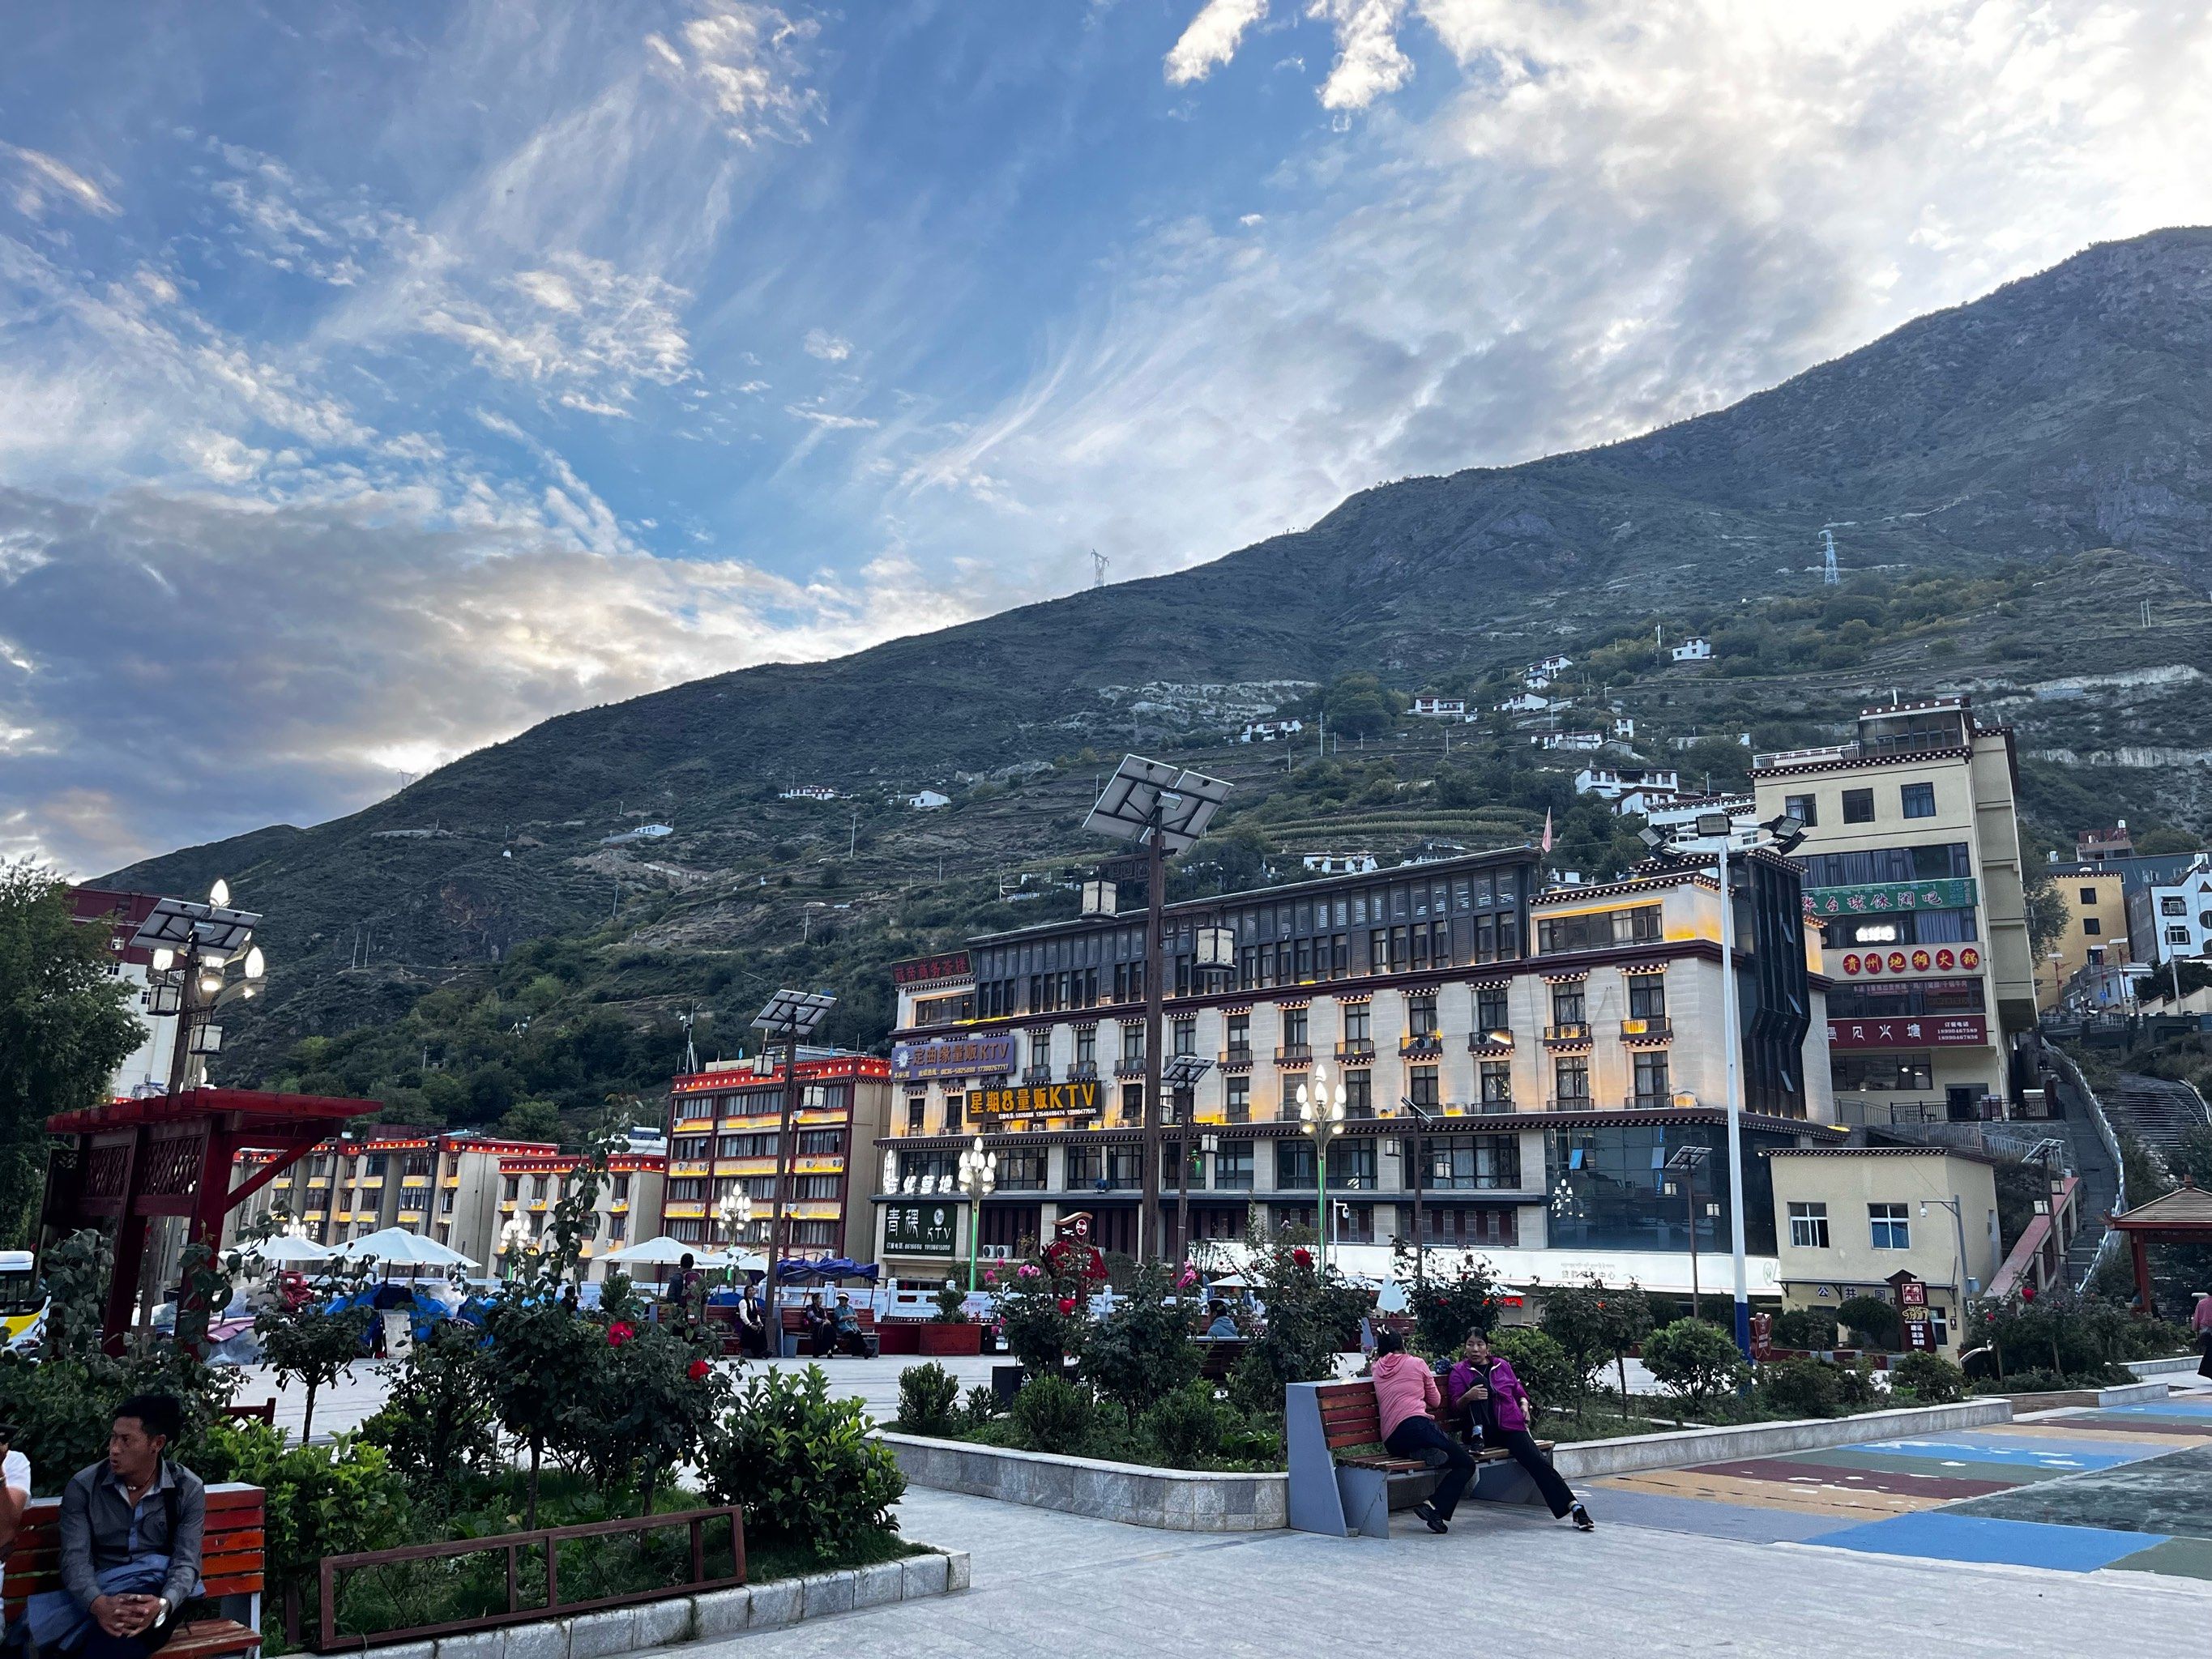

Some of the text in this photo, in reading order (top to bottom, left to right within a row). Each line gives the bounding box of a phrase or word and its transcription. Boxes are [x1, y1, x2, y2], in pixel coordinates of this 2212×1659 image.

[1847, 951, 1977, 974] 贵州地摊火锅
[913, 1043, 1010, 1066] 定曲缘量贩KTV
[970, 1083, 1095, 1115] 星期8量贩KTV
[886, 1206, 952, 1243] 青稞 KTV
[1561, 1269, 1616, 1281] 贷款中心
